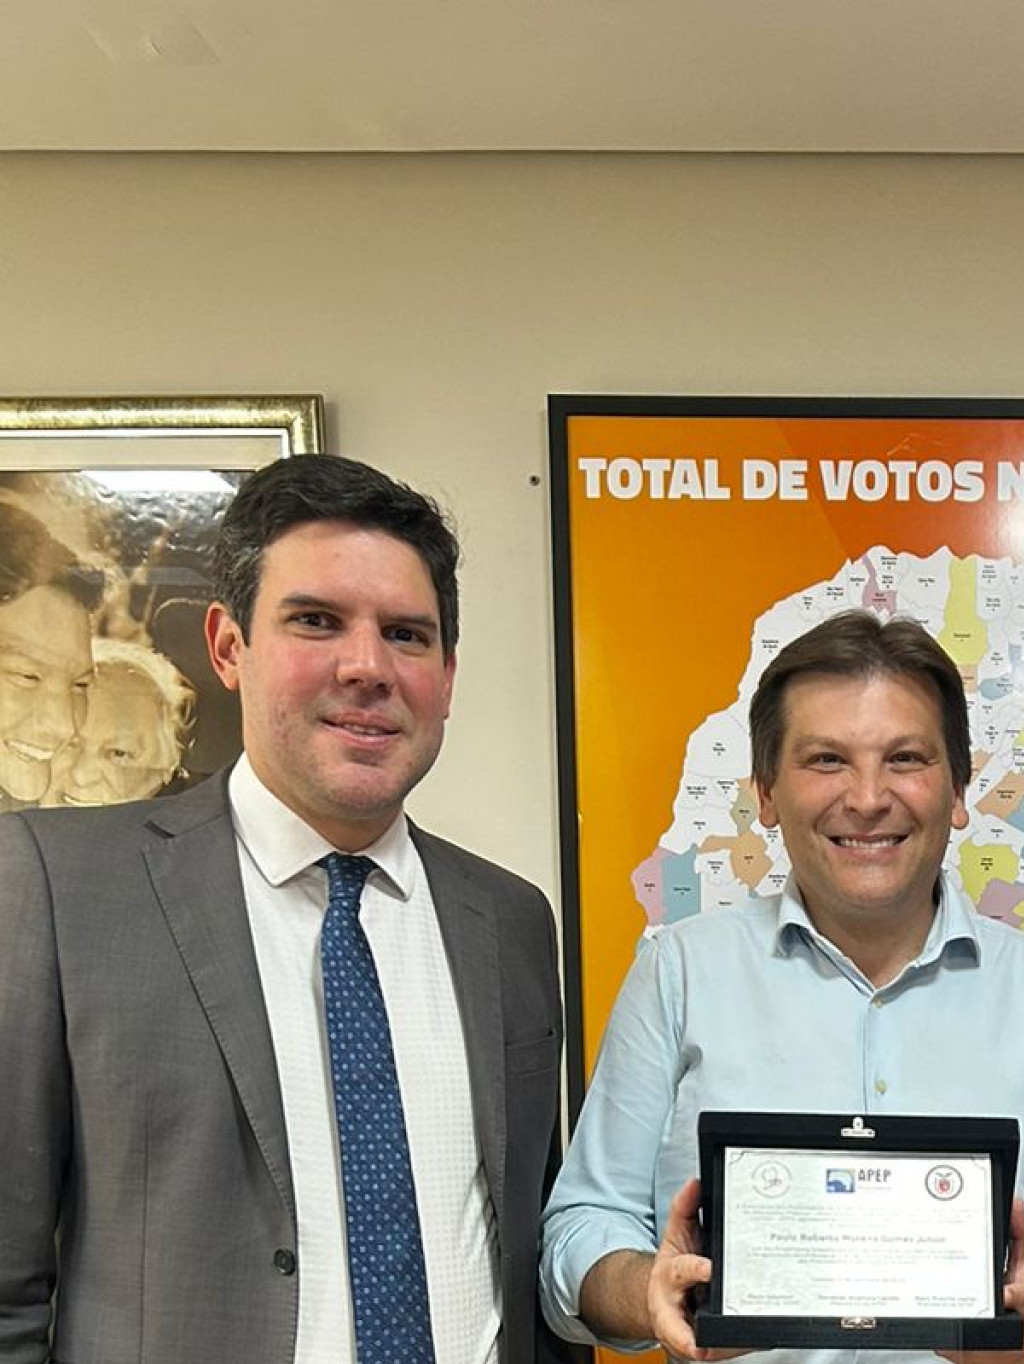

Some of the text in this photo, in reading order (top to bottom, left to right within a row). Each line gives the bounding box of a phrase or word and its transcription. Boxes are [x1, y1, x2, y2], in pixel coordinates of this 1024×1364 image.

[577, 457, 730, 500] TOTAL
[741, 458, 808, 501] DE
[818, 459, 986, 502] VOTOS
[857, 1168, 892, 1183] APEP
